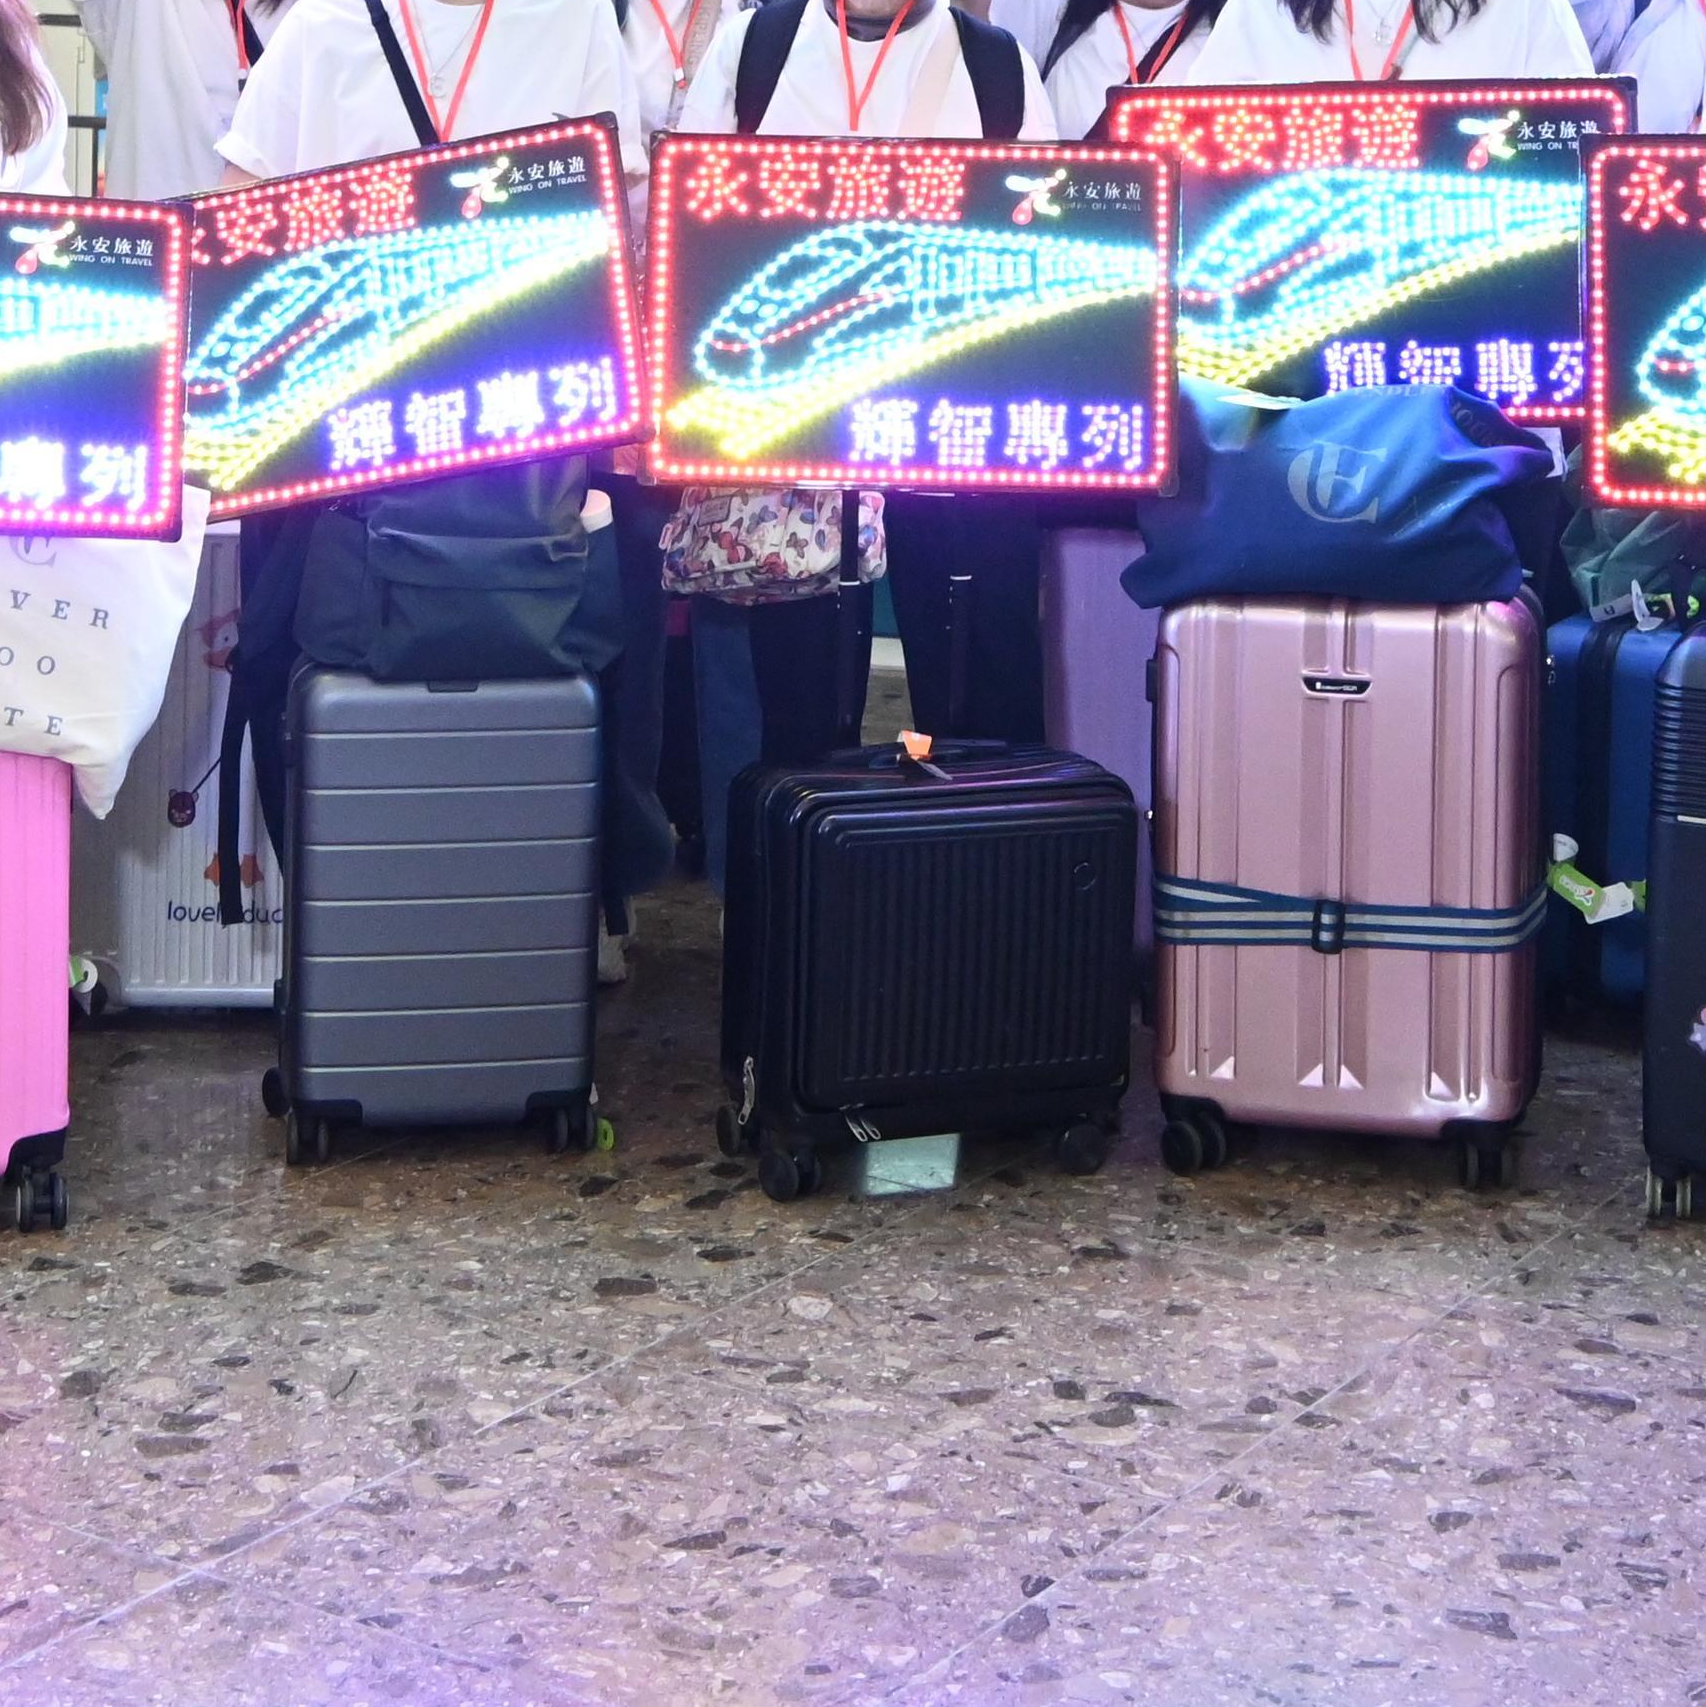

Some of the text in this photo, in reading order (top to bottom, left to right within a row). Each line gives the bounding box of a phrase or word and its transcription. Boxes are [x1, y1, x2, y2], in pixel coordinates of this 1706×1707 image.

[1517, 121, 1600, 139] 永安旅遊
[1517, 141, 1544, 151] WING
[1548, 141, 1562, 150] ON
[508, 156, 586, 184] 永安旅遊
[508, 174, 587, 195] WING ON TRAVEL
[686, 154, 967, 222] 永安旅遊
[1063, 181, 1143, 200] 永安旅遊
[69, 235, 155, 258] 永安旅遊
[69, 253, 153, 268] WING ON TRAVEL
[328, 356, 618, 472] 輝智專列
[849, 396, 1145, 470] 輝智專列
[167, 900, 227, 929] lovel
